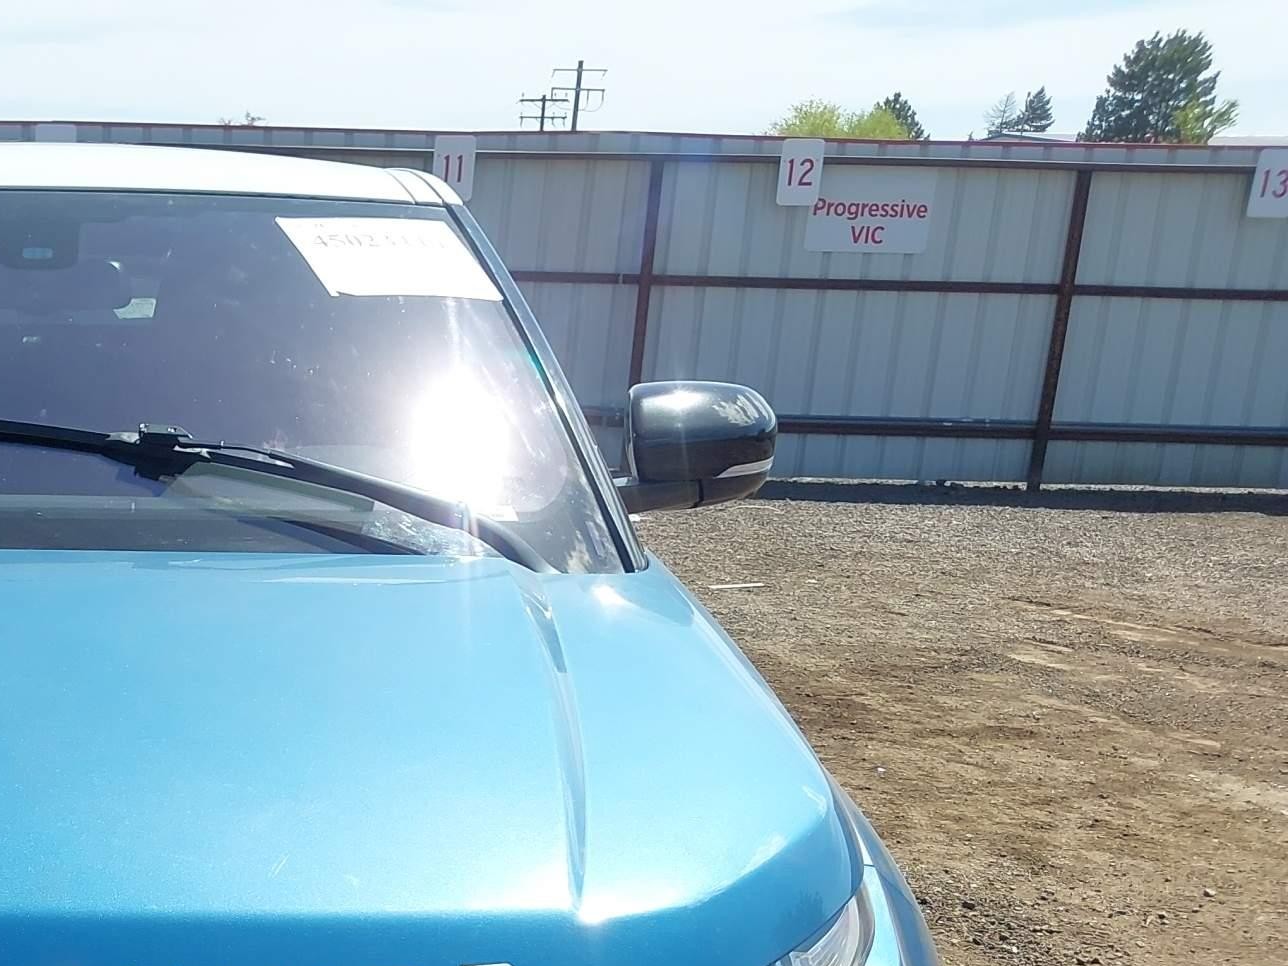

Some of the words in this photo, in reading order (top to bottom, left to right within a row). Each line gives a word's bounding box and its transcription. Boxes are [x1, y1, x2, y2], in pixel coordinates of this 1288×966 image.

[443, 153, 464, 184] 11
[786, 157, 815, 187] 12
[1259, 168, 1288, 199] 13
[813, 198, 928, 221] Progressive
[850, 225, 886, 245] VIC
